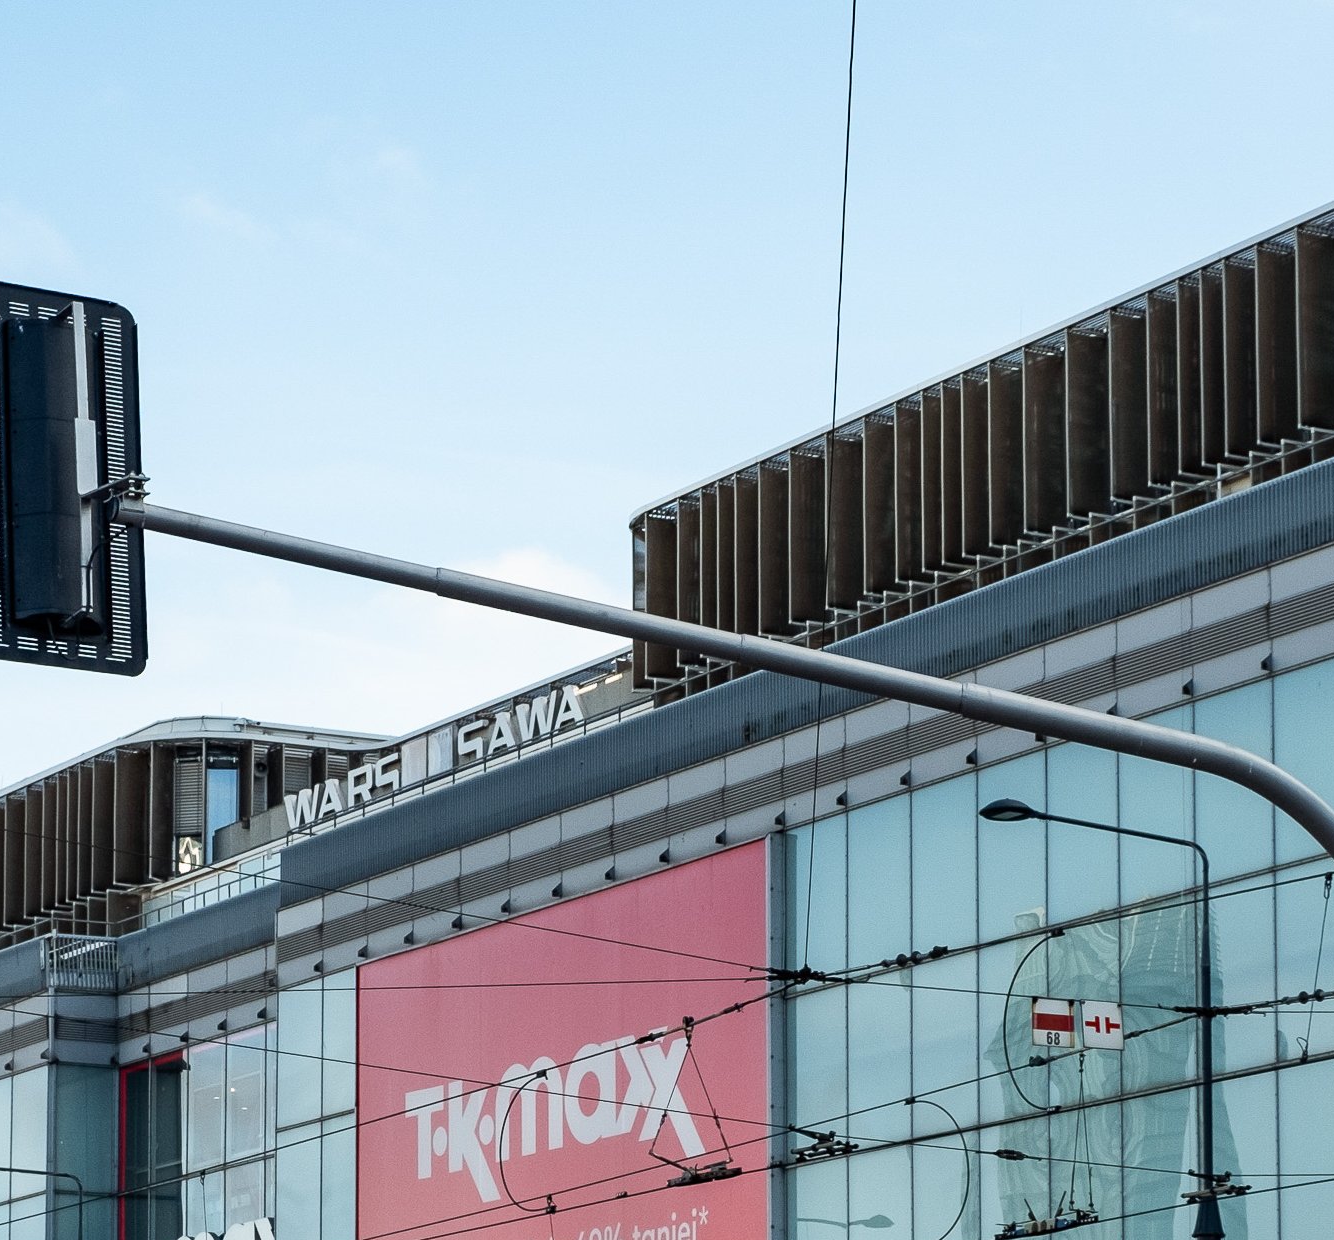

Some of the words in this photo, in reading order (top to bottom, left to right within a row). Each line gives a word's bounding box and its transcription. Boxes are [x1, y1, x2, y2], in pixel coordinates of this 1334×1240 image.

[284, 752, 400, 829] WARS
[457, 684, 585, 760] SAWA
[1047, 1031, 1061, 1046] 68
